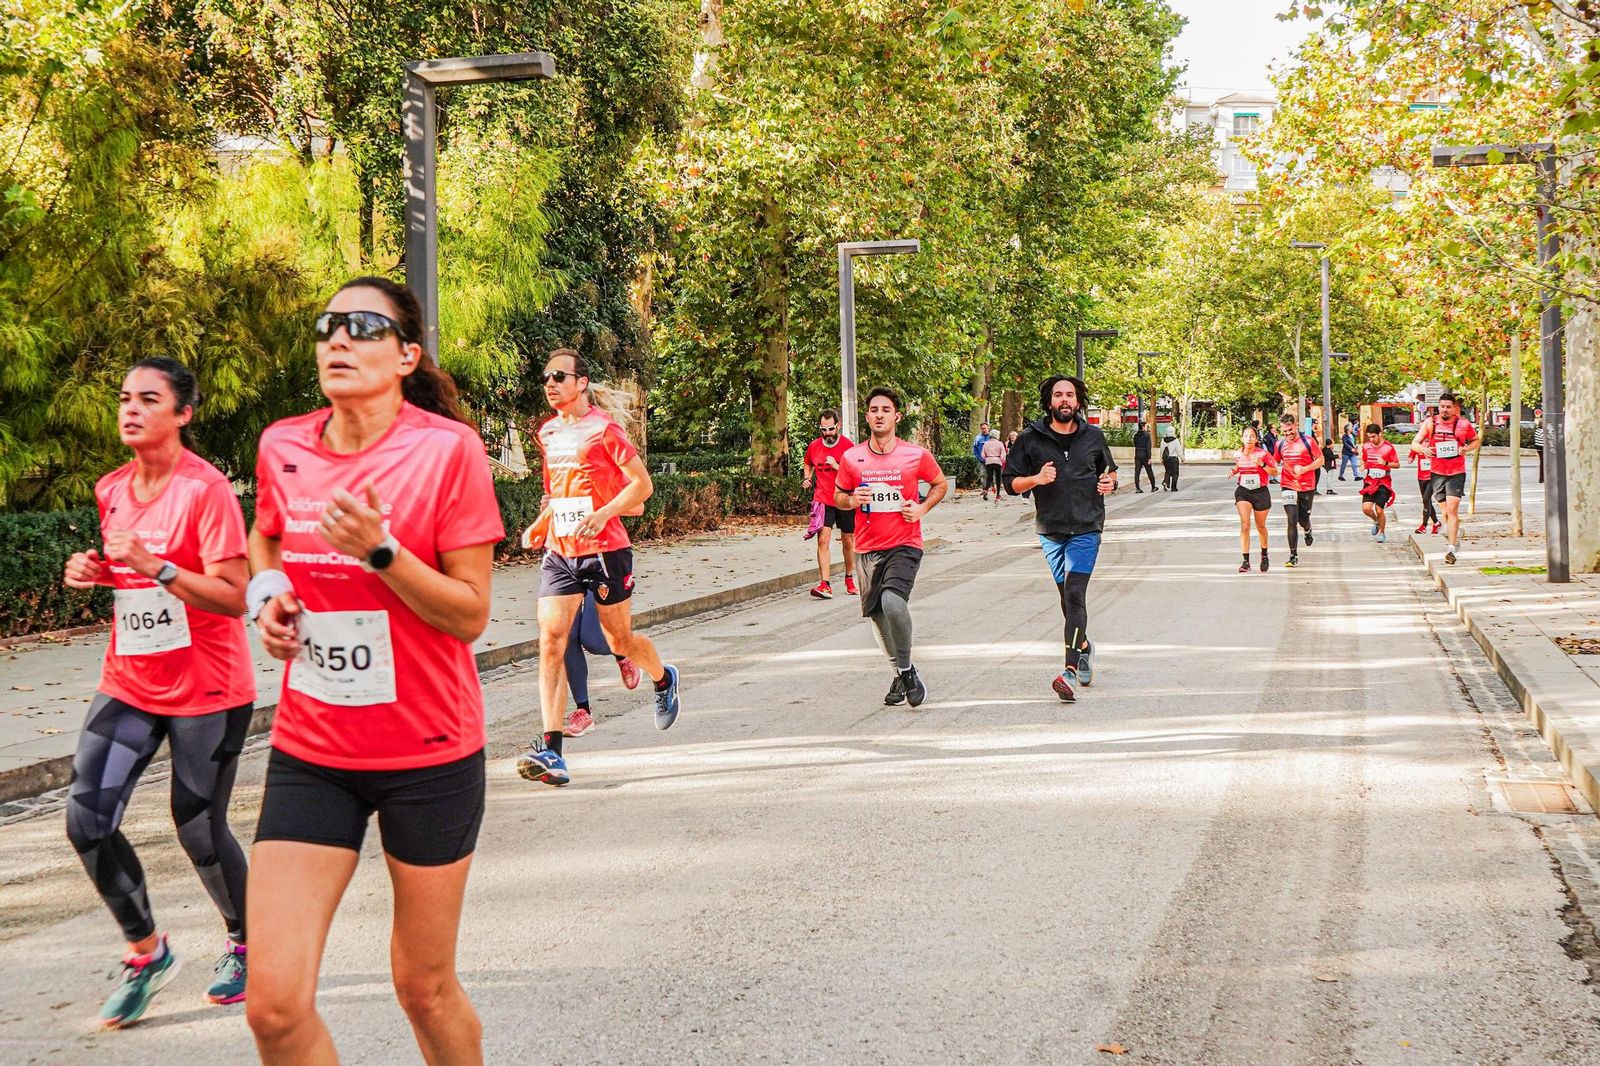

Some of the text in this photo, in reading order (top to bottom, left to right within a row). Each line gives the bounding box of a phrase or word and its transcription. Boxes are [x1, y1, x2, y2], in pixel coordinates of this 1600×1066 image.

[871, 493, 899, 501] 1818
[555, 510, 586, 523] 1135
[122, 608, 173, 632] 1064
[303, 636, 372, 672] 1550
